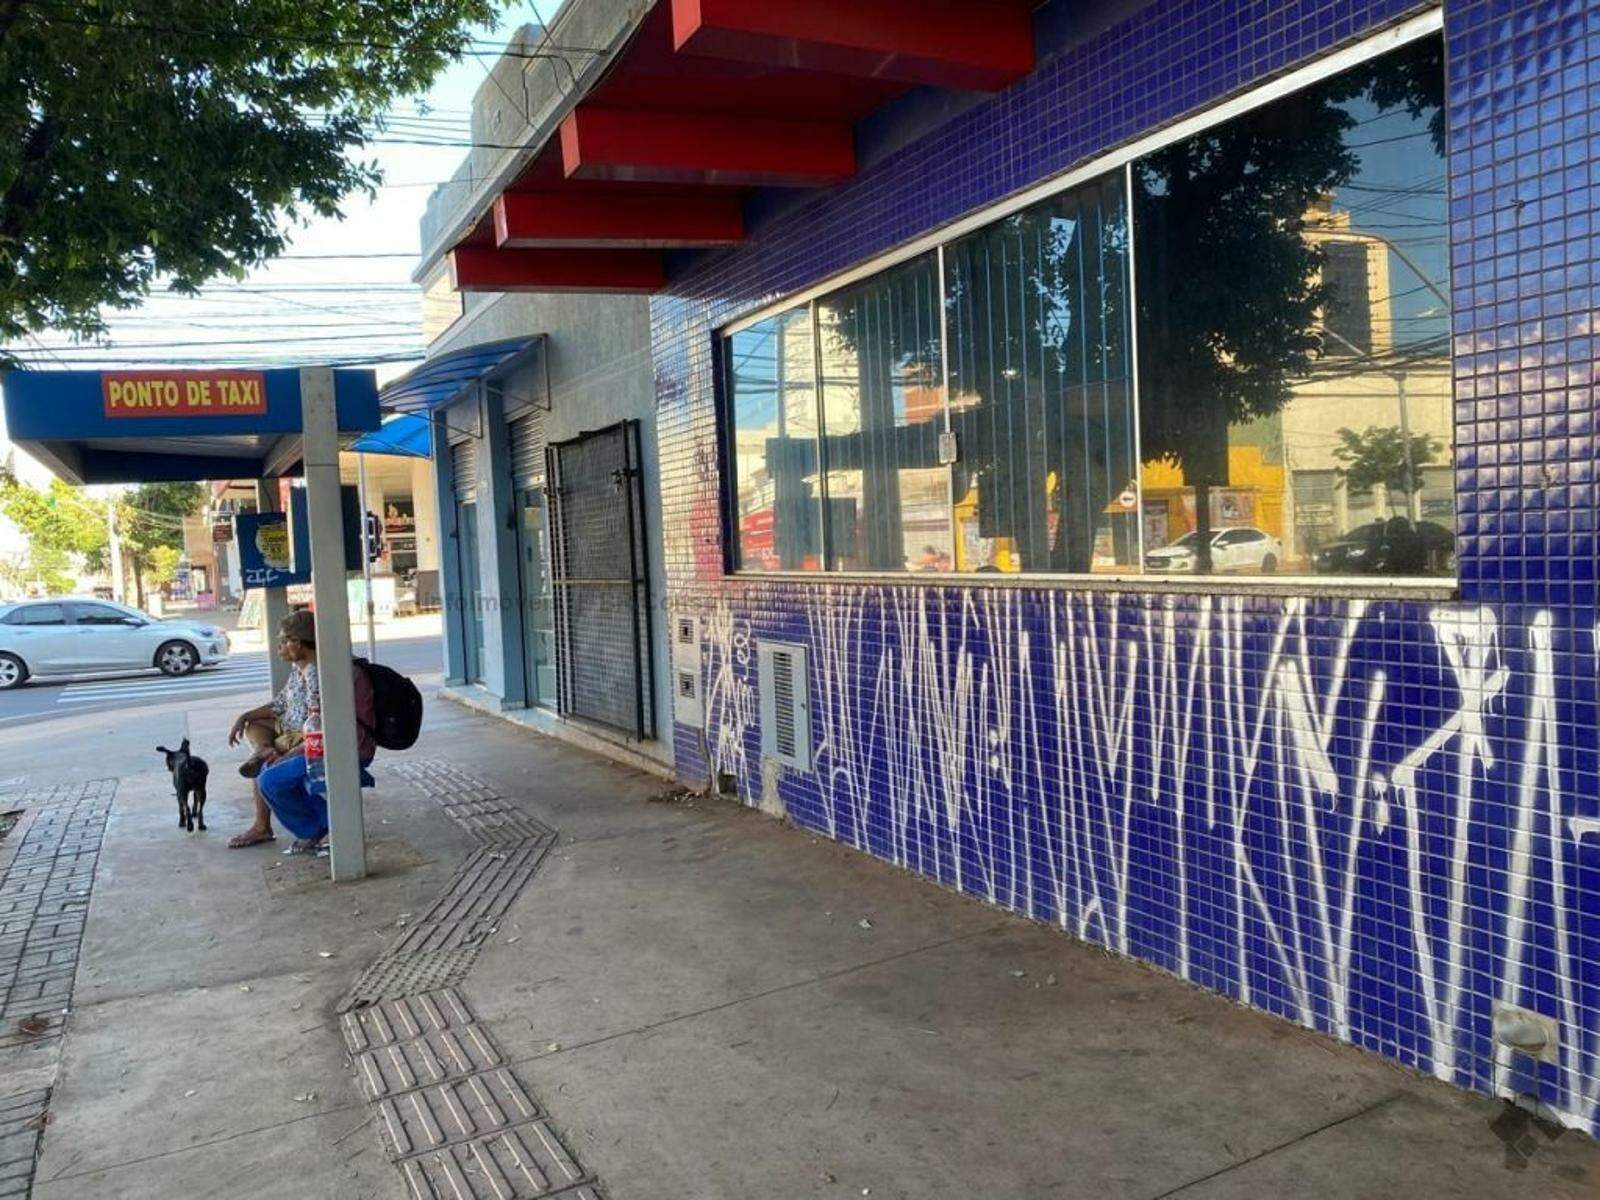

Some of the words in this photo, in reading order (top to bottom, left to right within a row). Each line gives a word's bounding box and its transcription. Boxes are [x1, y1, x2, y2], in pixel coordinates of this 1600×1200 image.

[108, 380, 180, 408] PONTO
[186, 380, 212, 407] DE
[217, 379, 261, 406] TAXI
